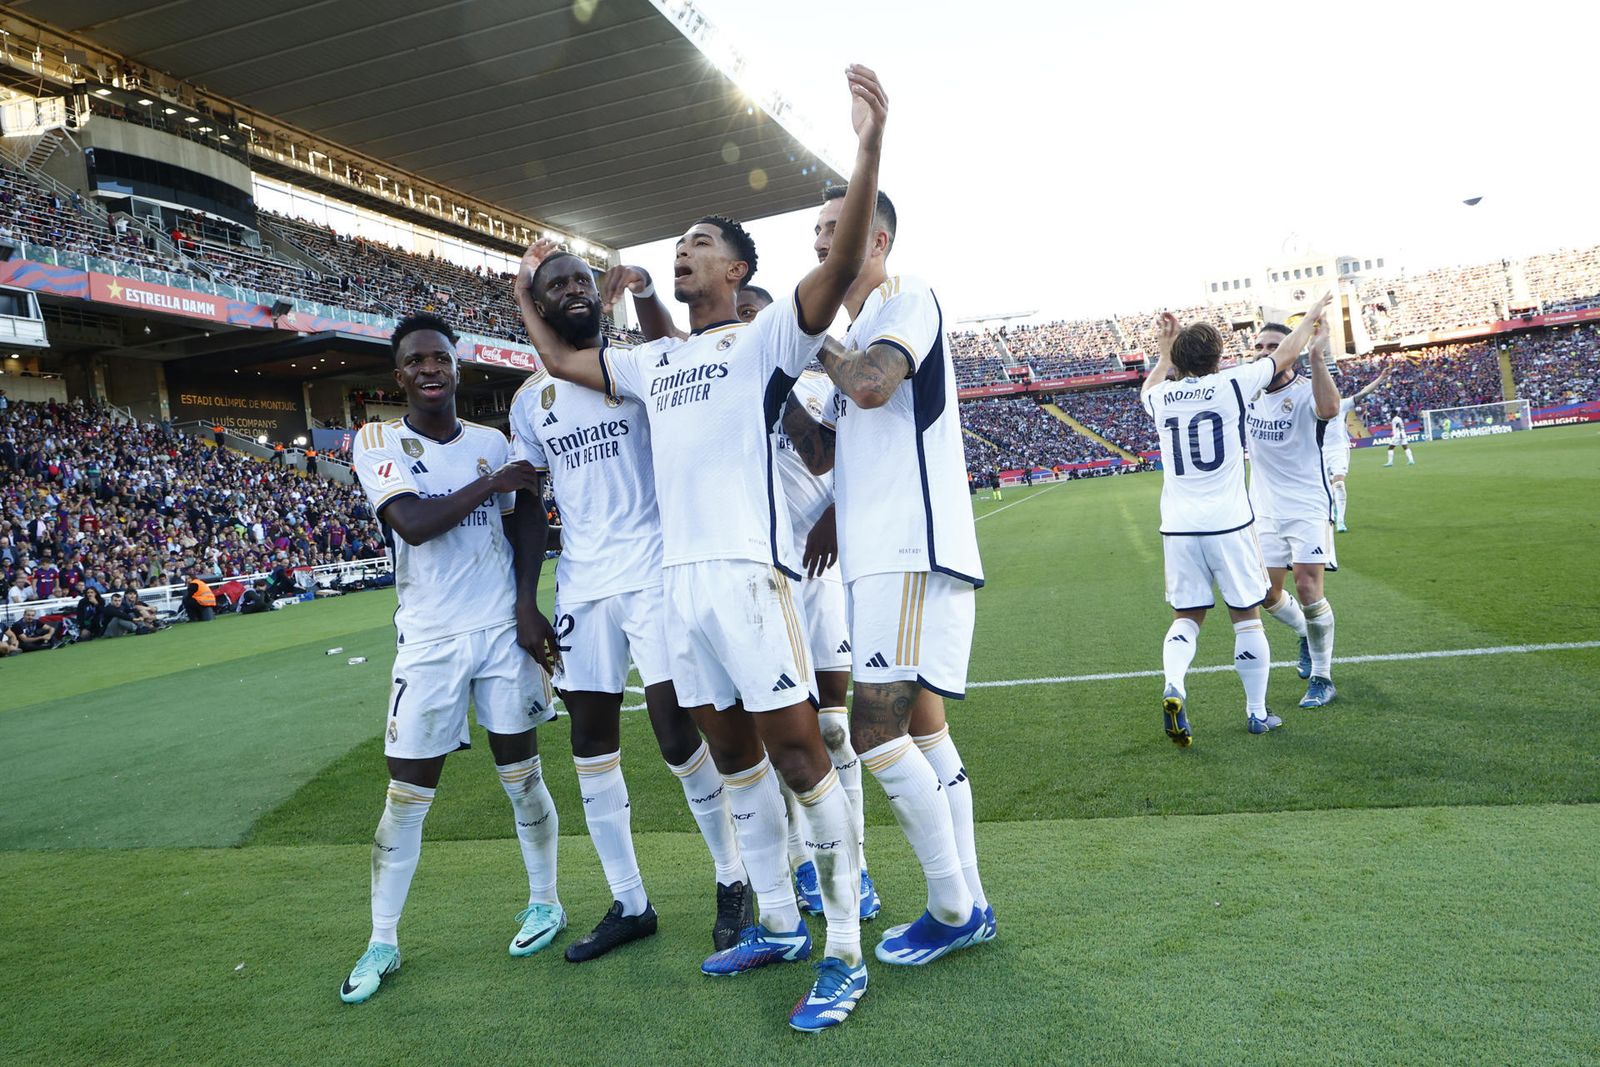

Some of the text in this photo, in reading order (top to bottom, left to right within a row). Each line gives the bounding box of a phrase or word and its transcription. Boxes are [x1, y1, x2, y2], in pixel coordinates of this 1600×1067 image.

[125, 288, 215, 316] ESTRELLA DAMM
[650, 361, 729, 397] Emirates
[181, 394, 213, 406] ESTADI
[249, 399, 260, 409] DE
[656, 383, 711, 413] FLY BETTER
[237, 418, 278, 429] COMPANYS
[546, 418, 630, 456] Emirates
[1259, 430, 1284, 441] BETTER
[566, 440, 620, 470] FLY BETTER
[1165, 411, 1225, 476] 10
[393, 677, 408, 717] 7
[805, 839, 842, 850] RMCF
